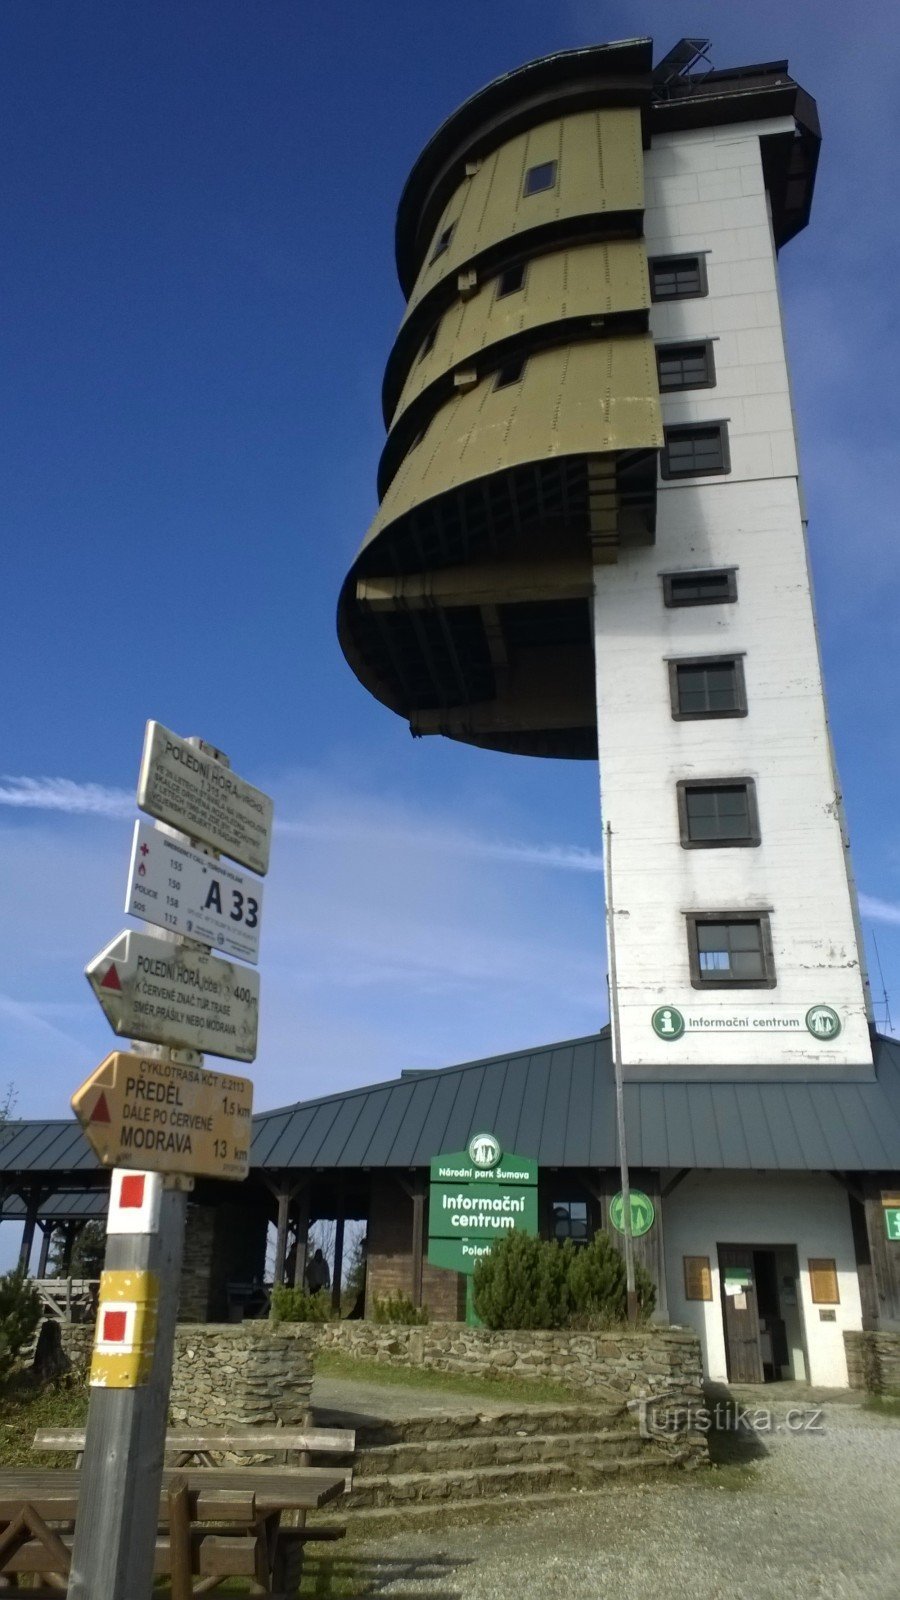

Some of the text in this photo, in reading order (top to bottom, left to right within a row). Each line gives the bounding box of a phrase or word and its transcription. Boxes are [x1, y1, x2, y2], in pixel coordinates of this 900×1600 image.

[166, 741, 209, 780] POLEDNÍ
[170, 859, 182, 872] 155
[168, 878, 181, 891] 150
[133, 901, 177, 926] SOS 112
[166, 896, 179, 909] 158
[205, 878, 225, 915] A
[230, 889, 259, 930] 33
[137, 956, 175, 981] POLEDNÍ
[234, 985, 250, 1003] 400
[689, 1017, 800, 1027] Informační centrum
[140, 1061, 200, 1084] CYKLOTRASA
[202, 1072, 218, 1087] KČT
[126, 1077, 184, 1106] PŘEDĚL
[238, 1104, 250, 1117] km
[123, 1104, 213, 1131] DÁLE PO ČERVENÉ
[121, 1126, 247, 1160] MODRAVA 13 km
[439, 1168, 529, 1179] Národní park Šumava
[442, 1194, 525, 1211] Informační
[451, 1213, 514, 1228] centrum
